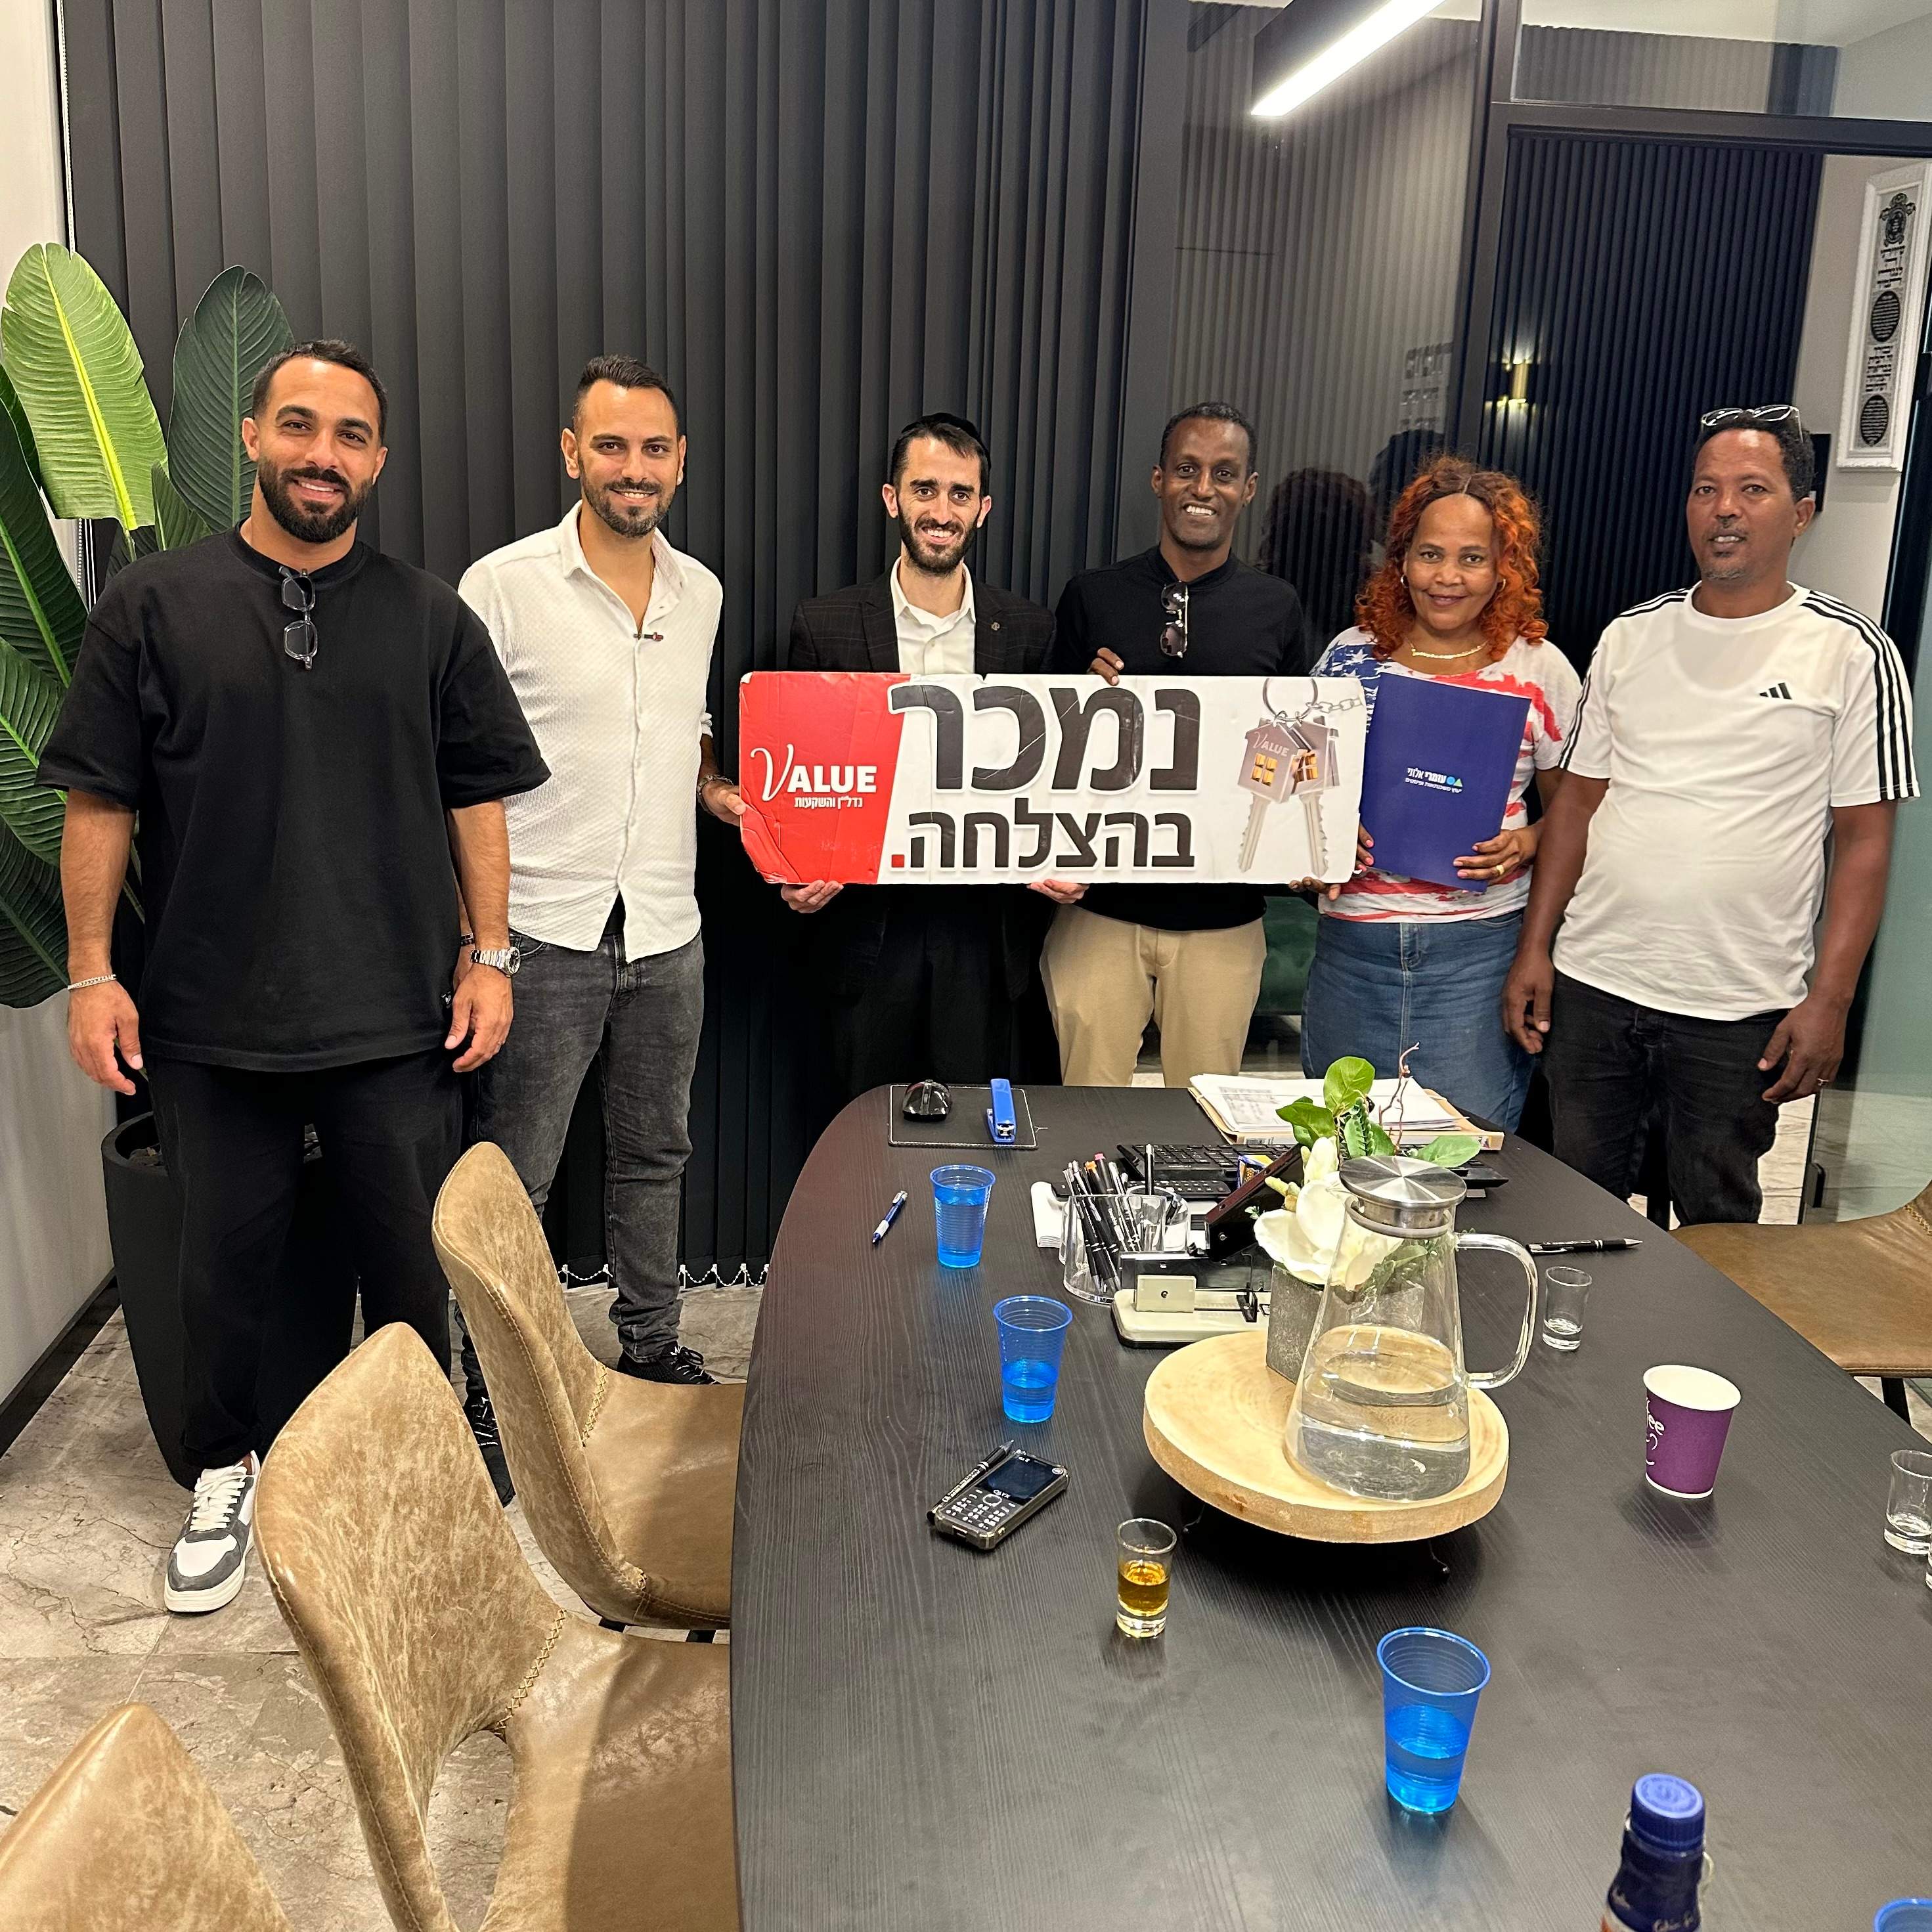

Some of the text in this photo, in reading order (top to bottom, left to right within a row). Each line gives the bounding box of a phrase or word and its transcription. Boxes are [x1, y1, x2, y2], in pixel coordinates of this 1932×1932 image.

[890, 684, 1200, 791] נמכר
[1253, 731, 1289, 757] VALUE
[750, 743, 877, 801] VALUE
[794, 797, 836, 810] והשקעות
[891, 797, 1195, 868] בהצלחה.
